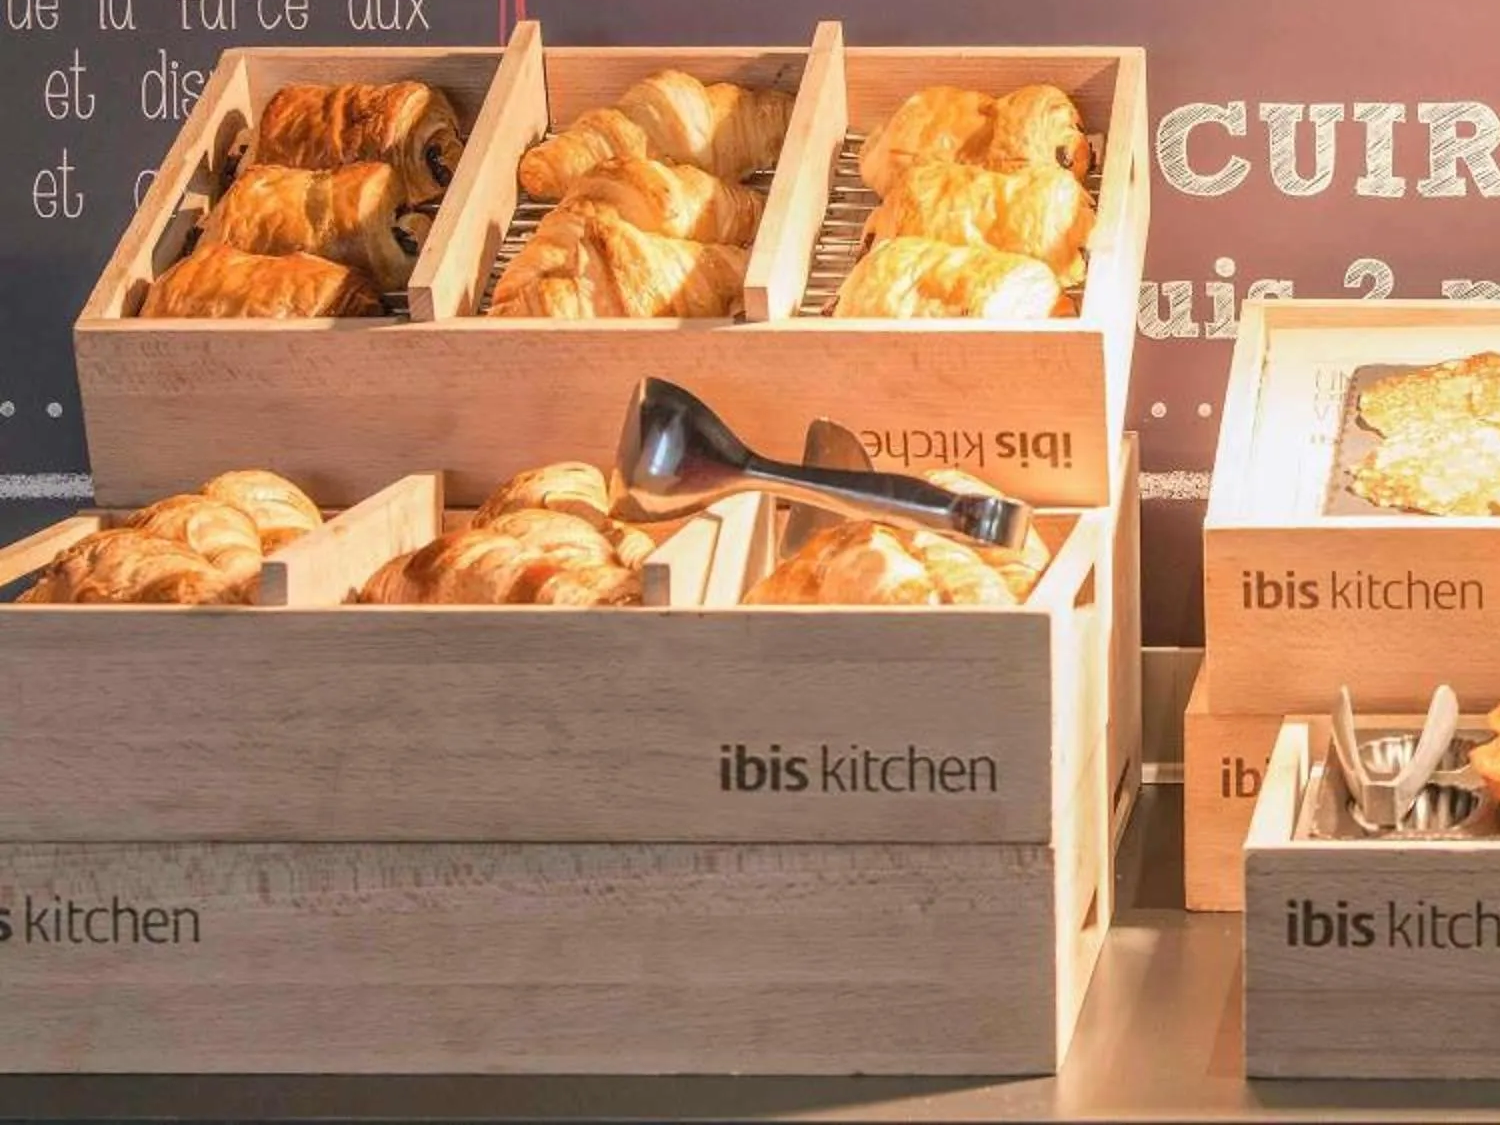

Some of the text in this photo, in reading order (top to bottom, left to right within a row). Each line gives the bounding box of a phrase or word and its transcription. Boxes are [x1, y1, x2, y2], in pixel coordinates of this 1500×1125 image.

[44, 48, 215, 120] et dis
[32, 147, 84, 219] et
[861, 429, 984, 469] kitche
[1242, 570, 1484, 611] ibis kitchen
[719, 744, 998, 794] ibis kitchen
[25, 893, 202, 945] kitchen
[1286, 898, 1376, 948] ibis
